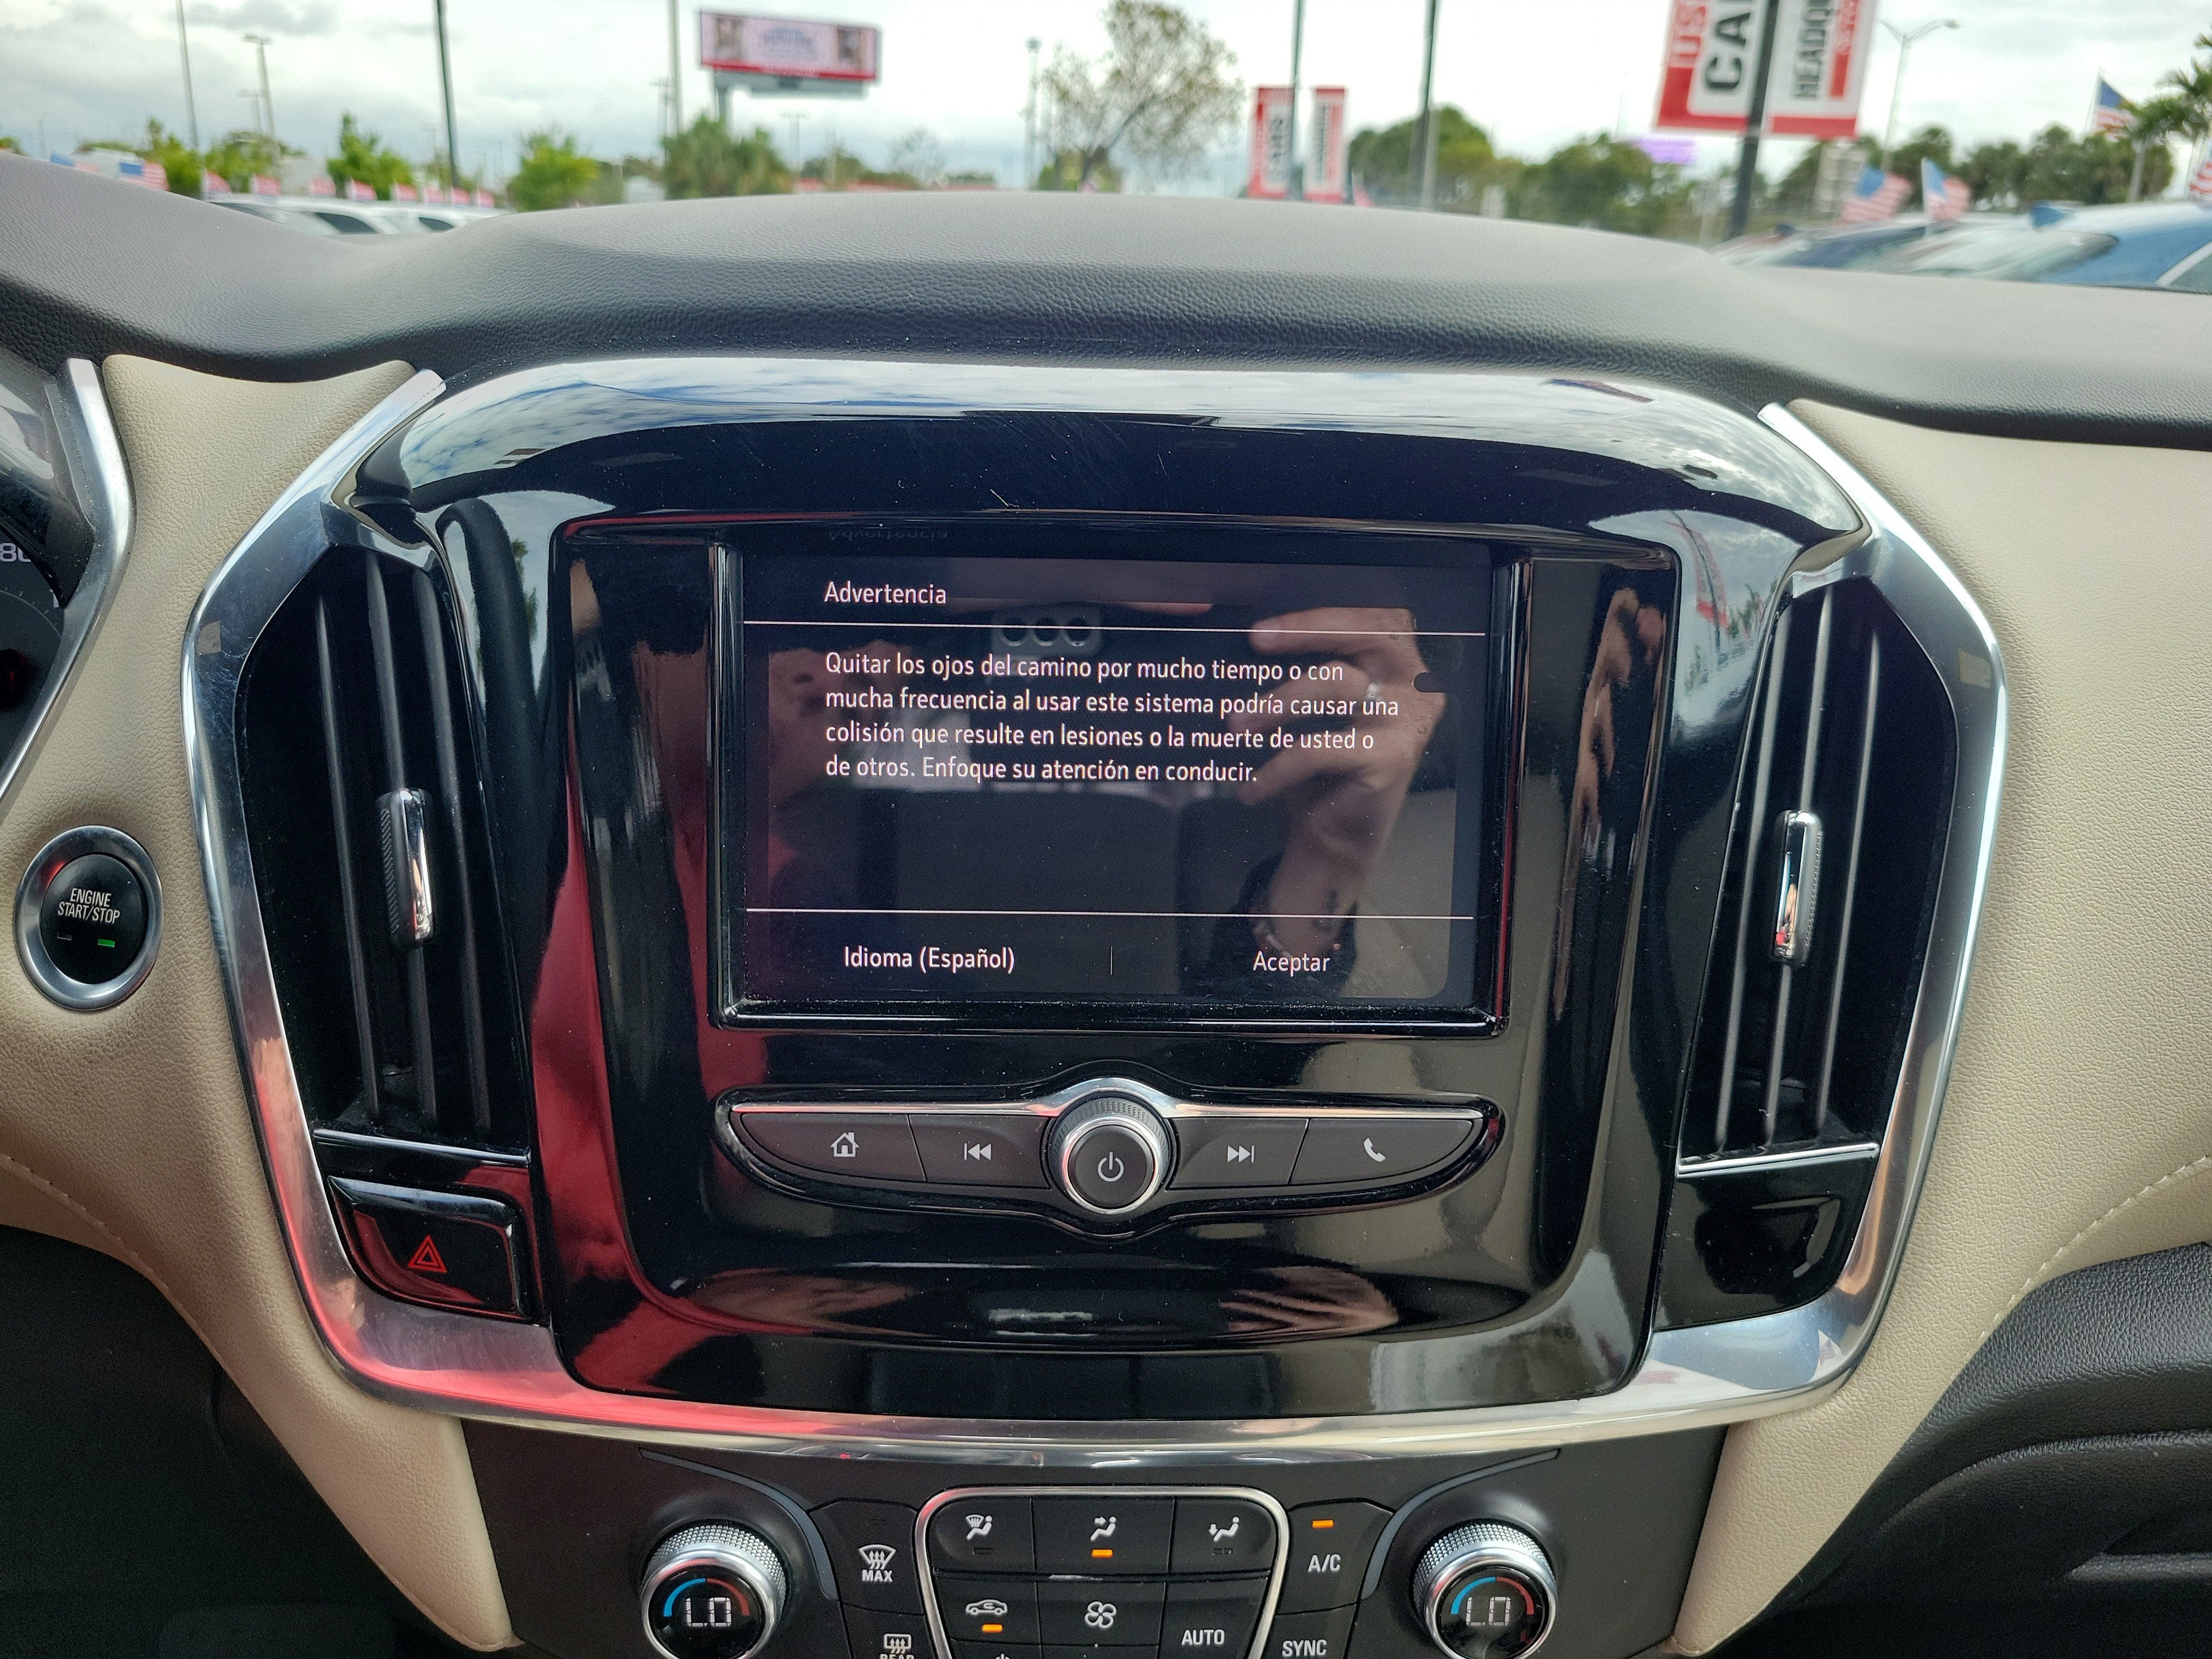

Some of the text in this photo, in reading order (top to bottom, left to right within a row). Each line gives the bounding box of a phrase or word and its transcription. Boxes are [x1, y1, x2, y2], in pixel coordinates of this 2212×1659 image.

[1705, 0, 1753, 89] CA
[824, 580, 946, 604] Advertencia
[826, 652, 1343, 686] Quitar los ojos del camino por mucho tiempo o con
[826, 686, 1399, 720] mucha frecuencia al usar este sistema podría causar una
[826, 720, 1374, 750] colisión que resulte en lesiones o la muerte de usted o
[826, 754, 1257, 784] de otros. Enfoque su atención en conducir.
[70, 888, 112, 907] ENGINE
[58, 901, 121, 924] START/STOP
[845, 945, 1014, 974] Idioma (Español)
[1253, 951, 1330, 977] Aceptar
[1307, 1554, 1341, 1573] A/C
[861, 1570, 894, 1583] MAX
[1181, 1629, 1226, 1646] AUTO
[1281, 1639, 1327, 1658] SYNC
